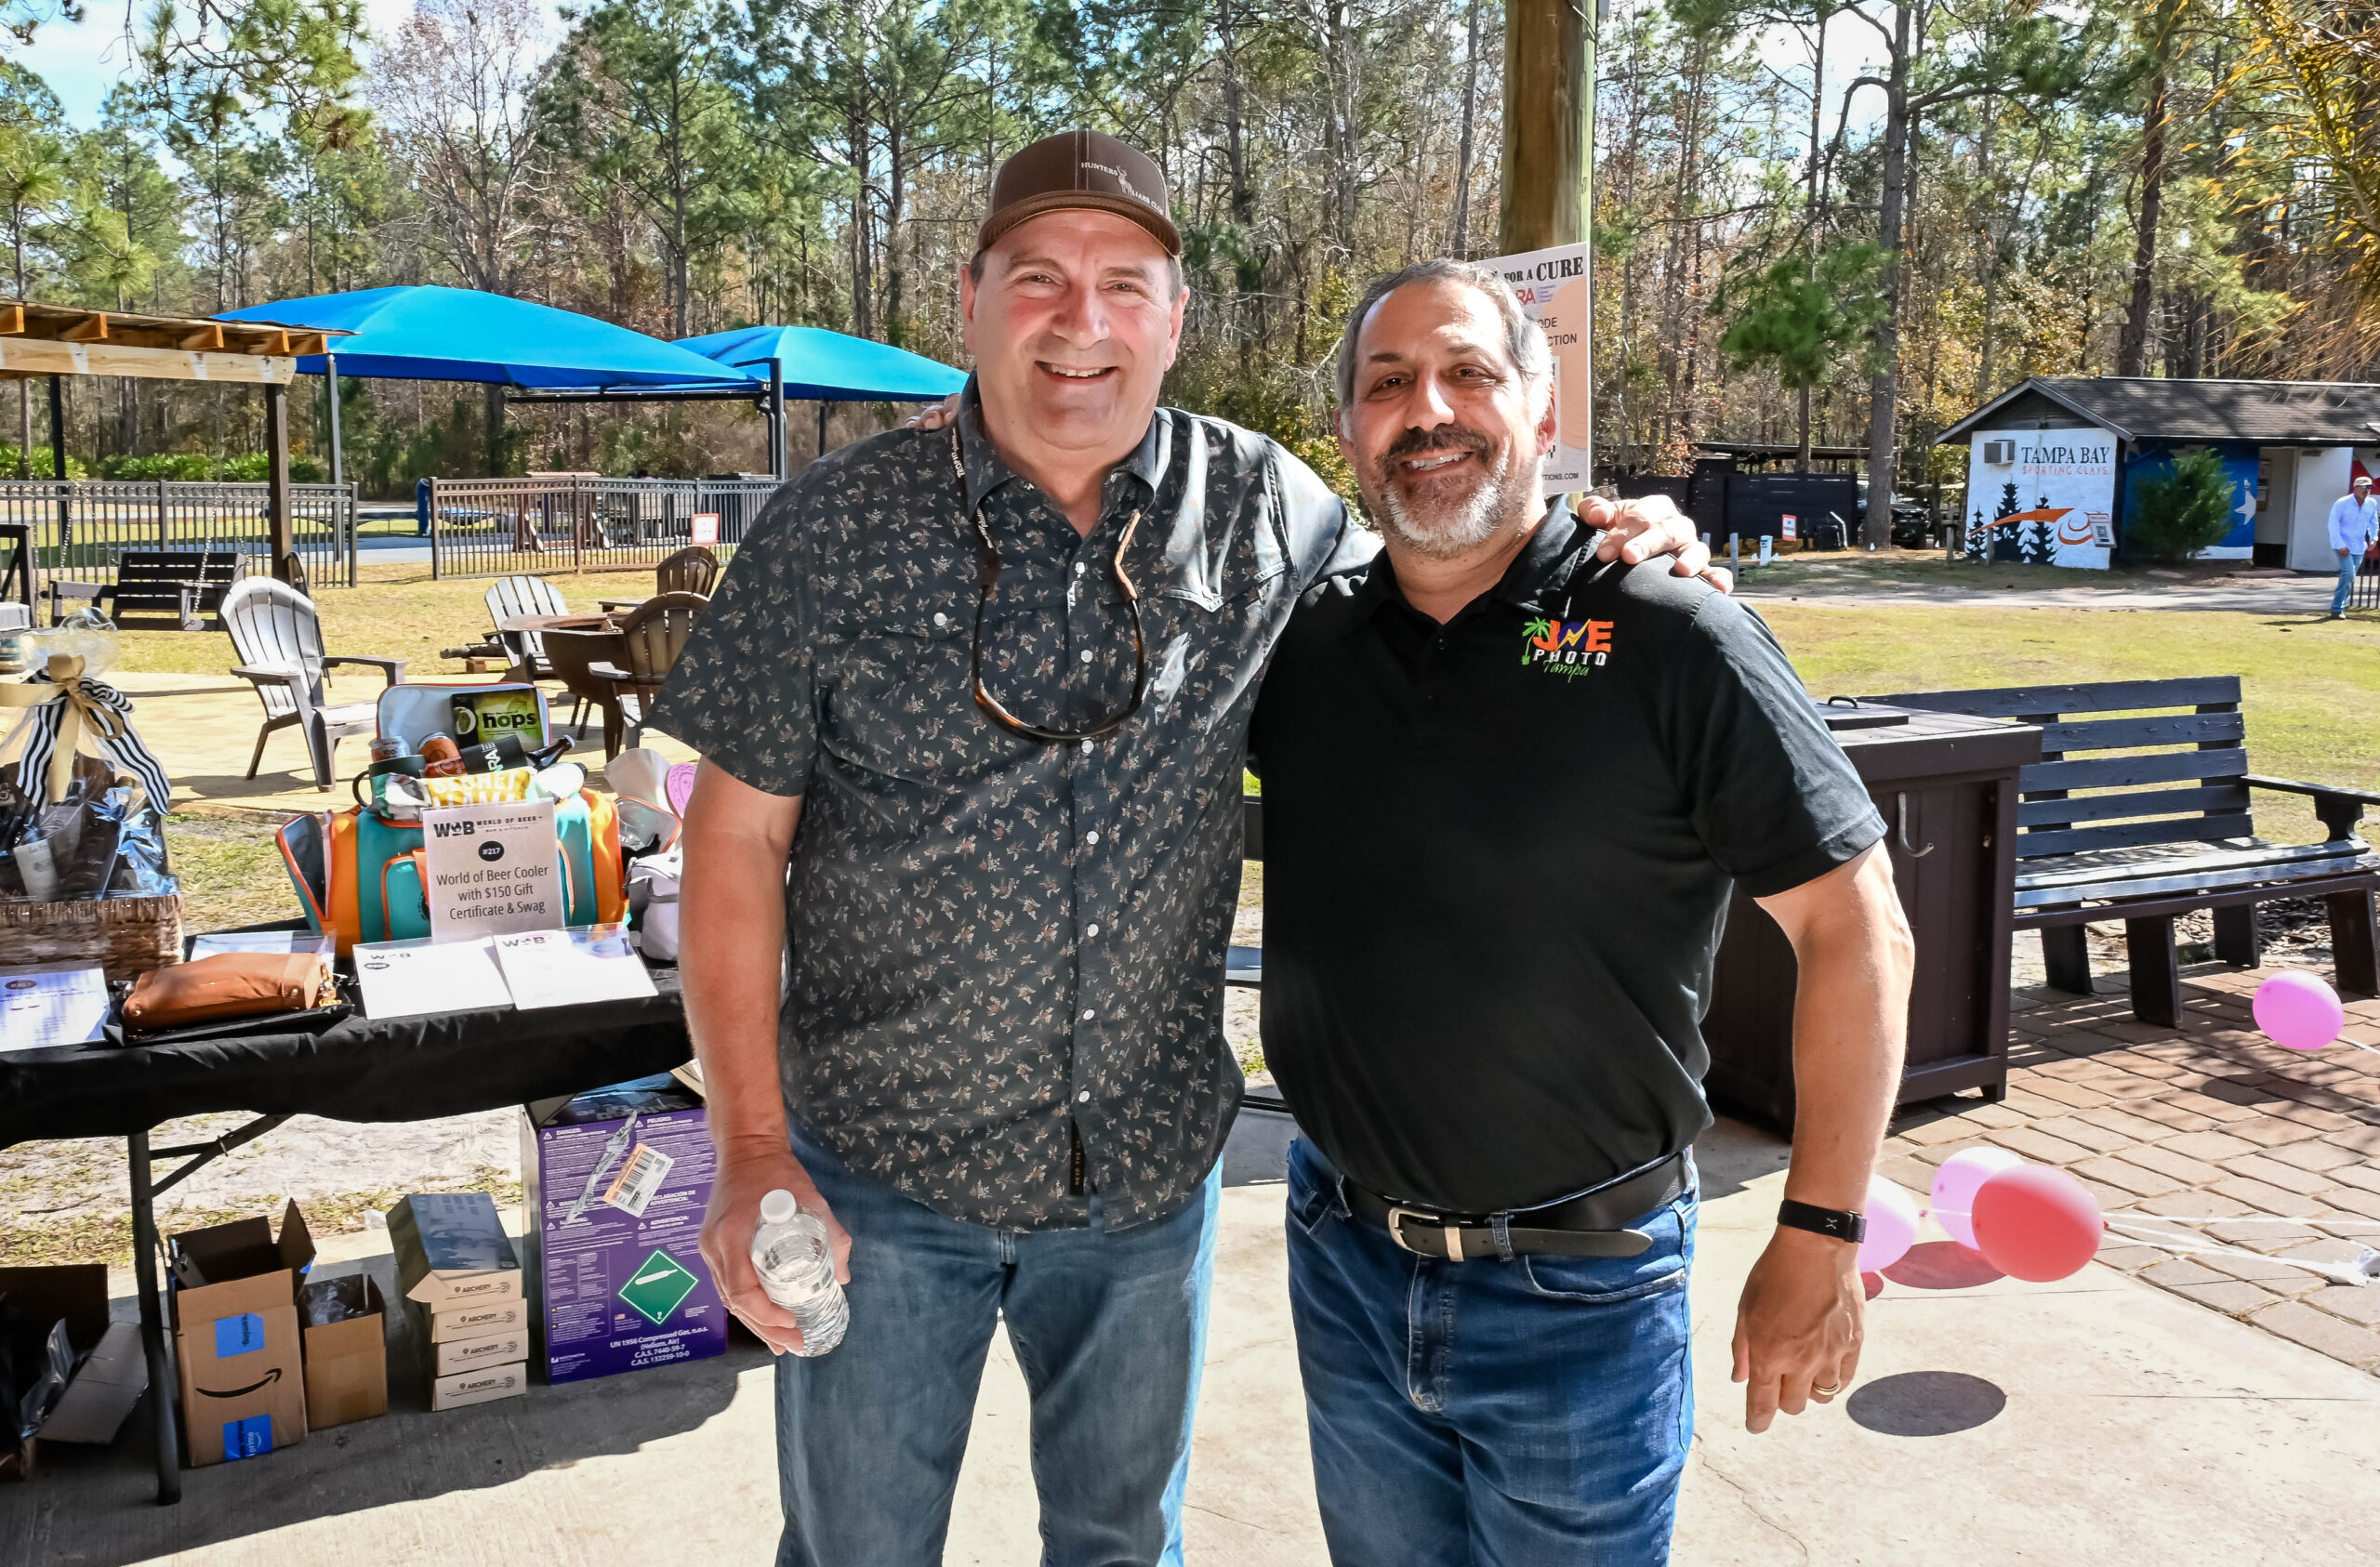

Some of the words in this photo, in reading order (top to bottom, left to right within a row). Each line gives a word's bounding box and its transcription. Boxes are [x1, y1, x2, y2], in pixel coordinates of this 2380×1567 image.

[1081, 162, 1118, 177] HUNTERS
[1504, 270, 1525, 283] FOR
[1527, 269, 1534, 281] A
[1536, 257, 1584, 282] CURE
[1538, 317, 1558, 329] ODE
[1547, 334, 1578, 347] CTION
[2021, 446, 2076, 464] TAMPA
[2080, 446, 2110, 464] BAY
[1542, 472, 1579, 481] TIONS.COM
[2022, 466, 2072, 475] SPORTING
[2076, 466, 2109, 475] CLAYS
[1532, 649, 1607, 666] PHOTO
[1542, 659, 1590, 683] Tampa
[482, 712, 537, 729] hops
[483, 847, 501, 855] #217
[436, 872, 469, 886] World
[473, 870, 484, 883] of
[487, 868, 511, 882] Beer
[514, 865, 549, 879] Cooler
[458, 888, 483, 902] with
[485, 885, 511, 899] $150
[514, 883, 534, 896] Gift
[449, 904, 504, 920] Certificate
[507, 902, 515, 914] &
[517, 901, 546, 915] Swag
[462, 1284, 491, 1293] ARCHERY
[468, 1313, 496, 1323] ARCHERY
[656, 1311, 663, 1320] 2
[622, 1338, 638, 1347] 1956
[638, 1331, 678, 1343] Compressed
[470, 1344, 499, 1354] ARCHERY
[634, 1350, 653, 1359] C.A.S.
[631, 1358, 650, 1366] C.A.S.
[468, 1379, 496, 1389] ARCHERY
